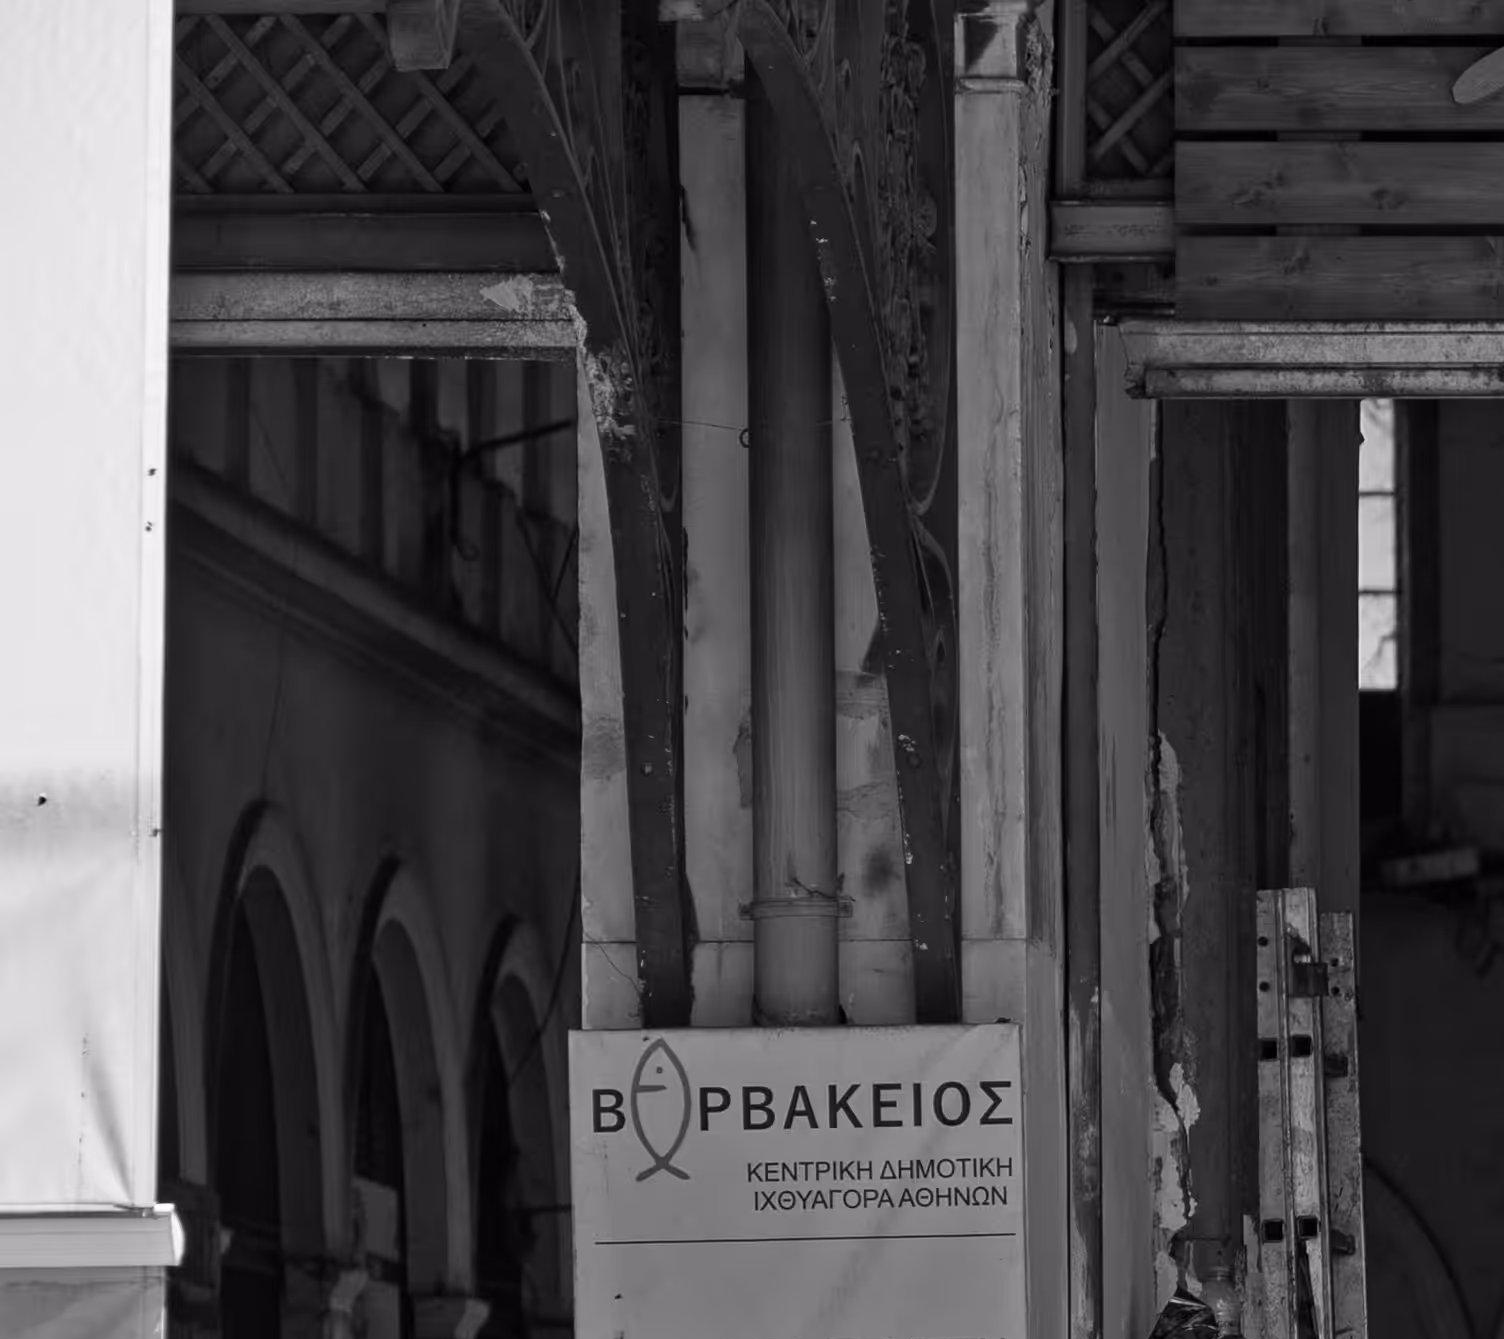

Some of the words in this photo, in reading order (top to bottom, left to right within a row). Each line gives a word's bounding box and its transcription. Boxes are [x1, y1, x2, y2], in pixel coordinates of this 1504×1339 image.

[747, 1160, 873, 1183] ΚΕΝΤΡΙΚΗ
[880, 1157, 1013, 1180] ΔΗΜΟΤΙΚΗ
[754, 1189, 894, 1211] ΙΧΘΥΑΓΟΡΑ
[899, 1187, 1007, 1208] ΑΘΗΝΩΝ
